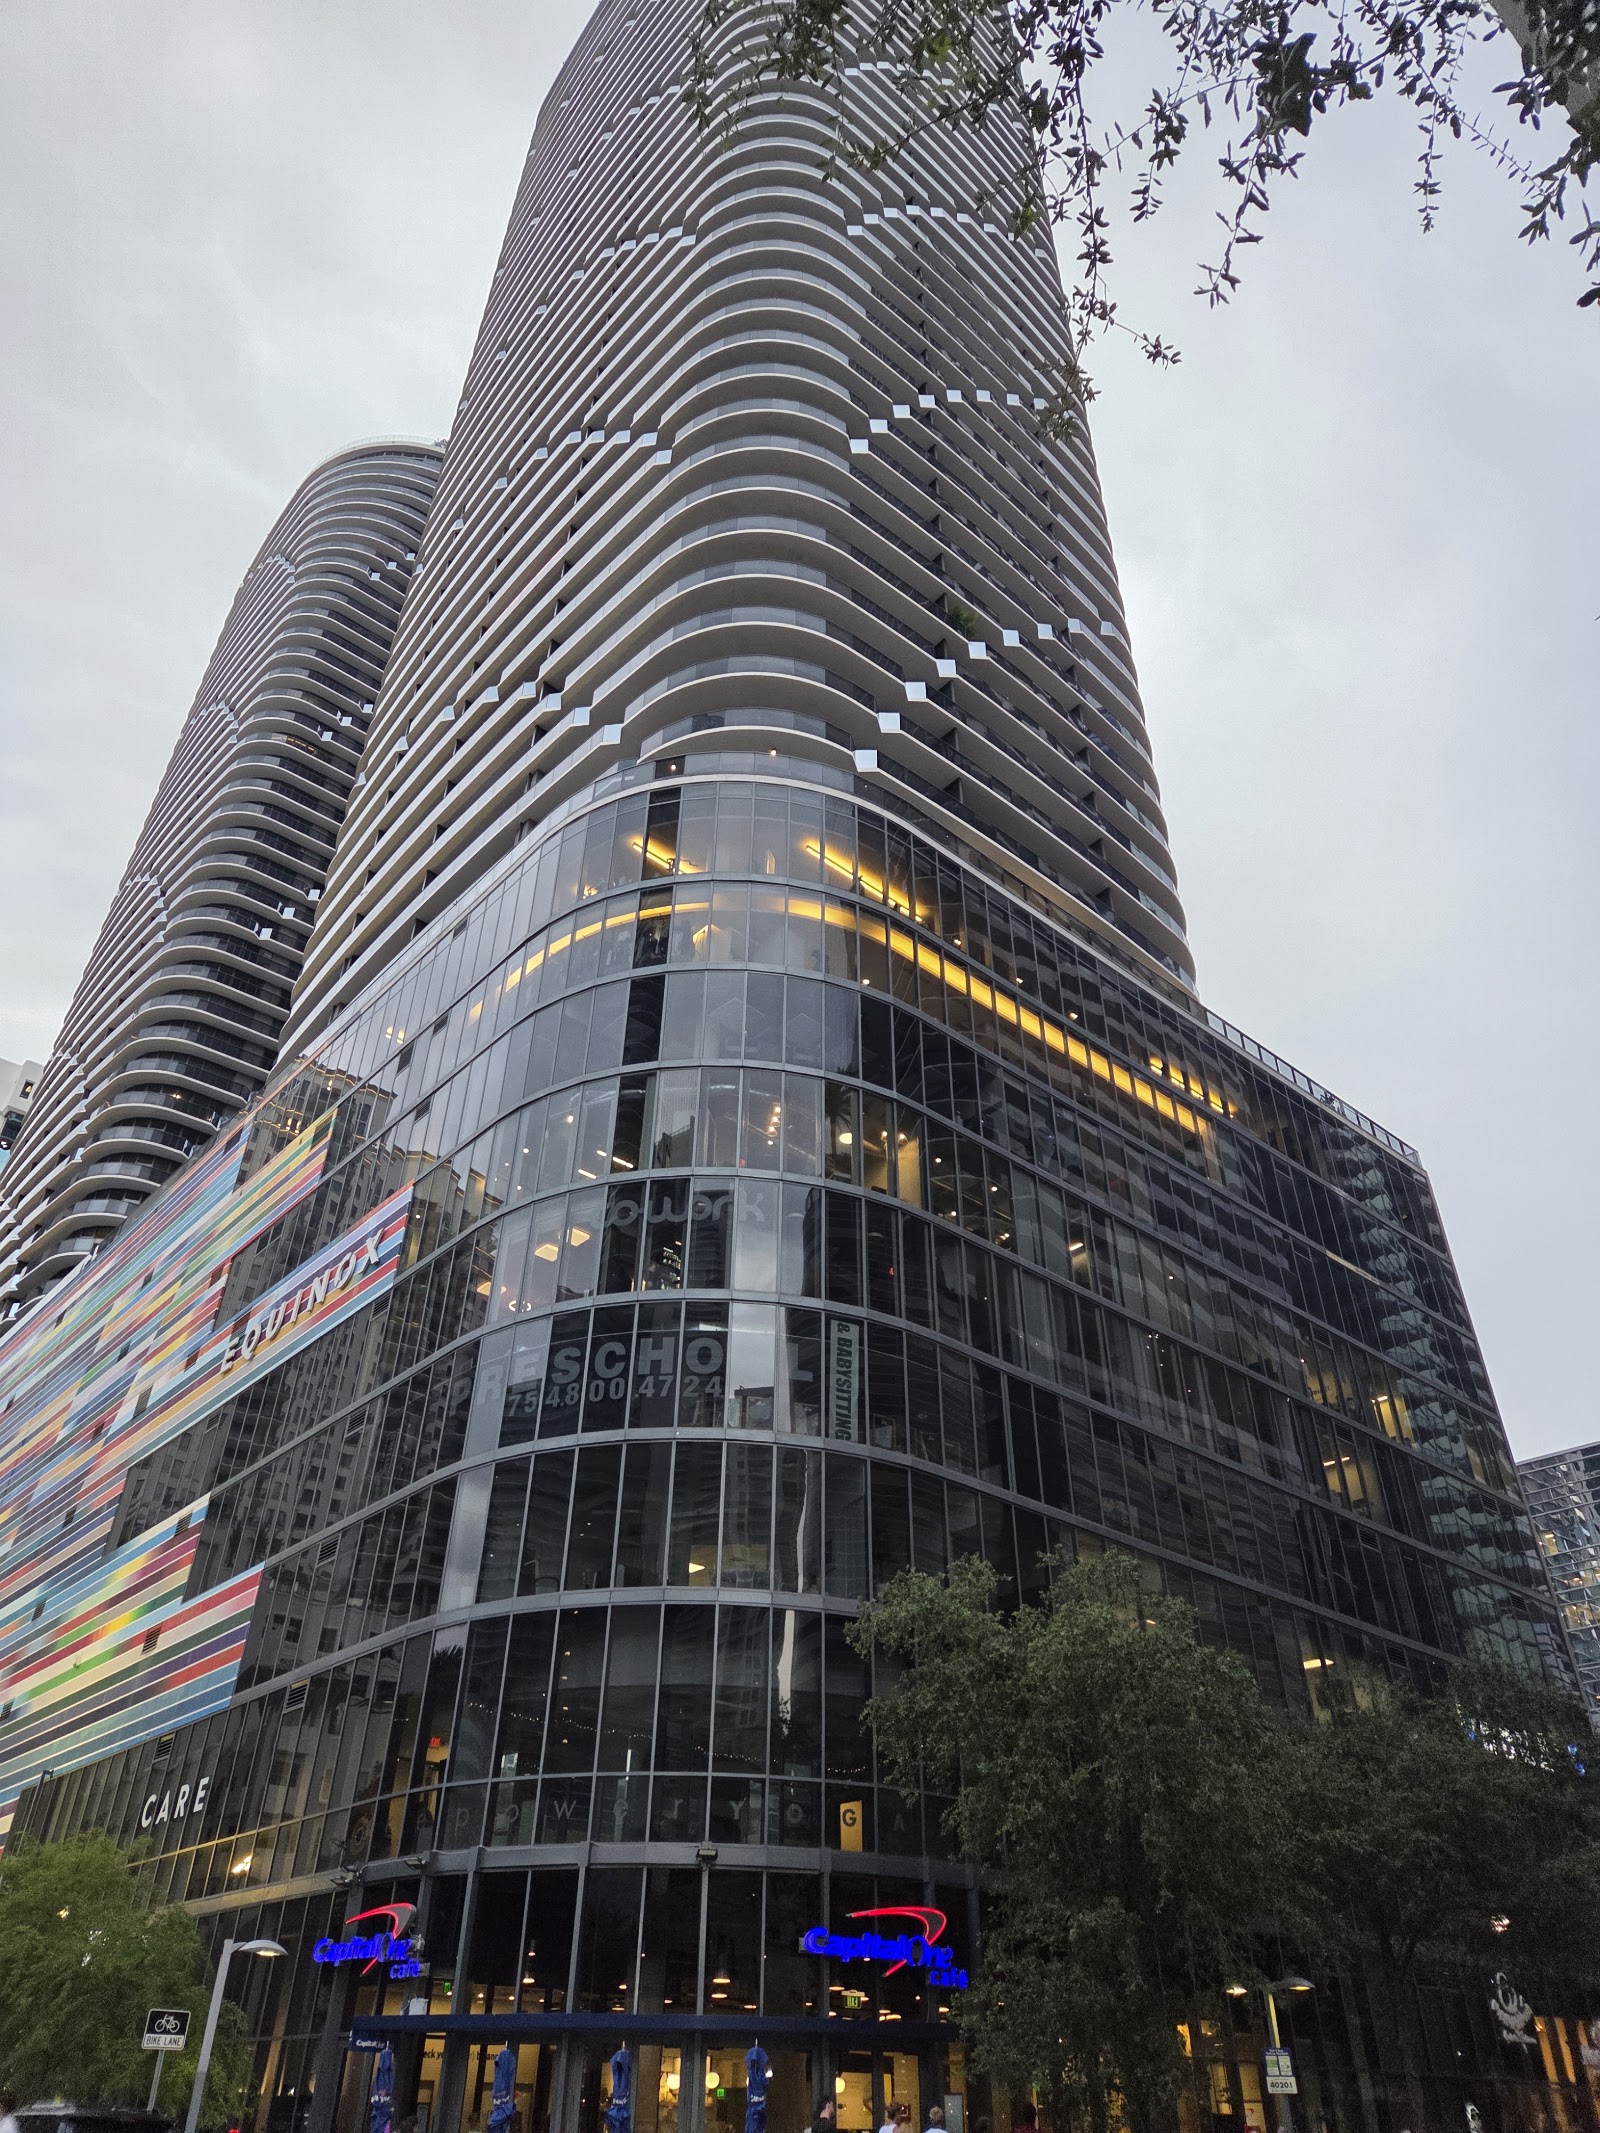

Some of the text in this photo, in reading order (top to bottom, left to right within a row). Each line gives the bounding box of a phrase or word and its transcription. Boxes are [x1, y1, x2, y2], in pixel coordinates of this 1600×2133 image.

[220, 1228, 384, 1374] EQUINOX
[449, 1336, 813, 1418] PRESCHOL
[835, 1338, 853, 1441] BABYSITTING
[141, 1776, 210, 1828] CARE
[145, 2035, 182, 2047] BIKE LANE
[1270, 2081, 1293, 2089] 40201
